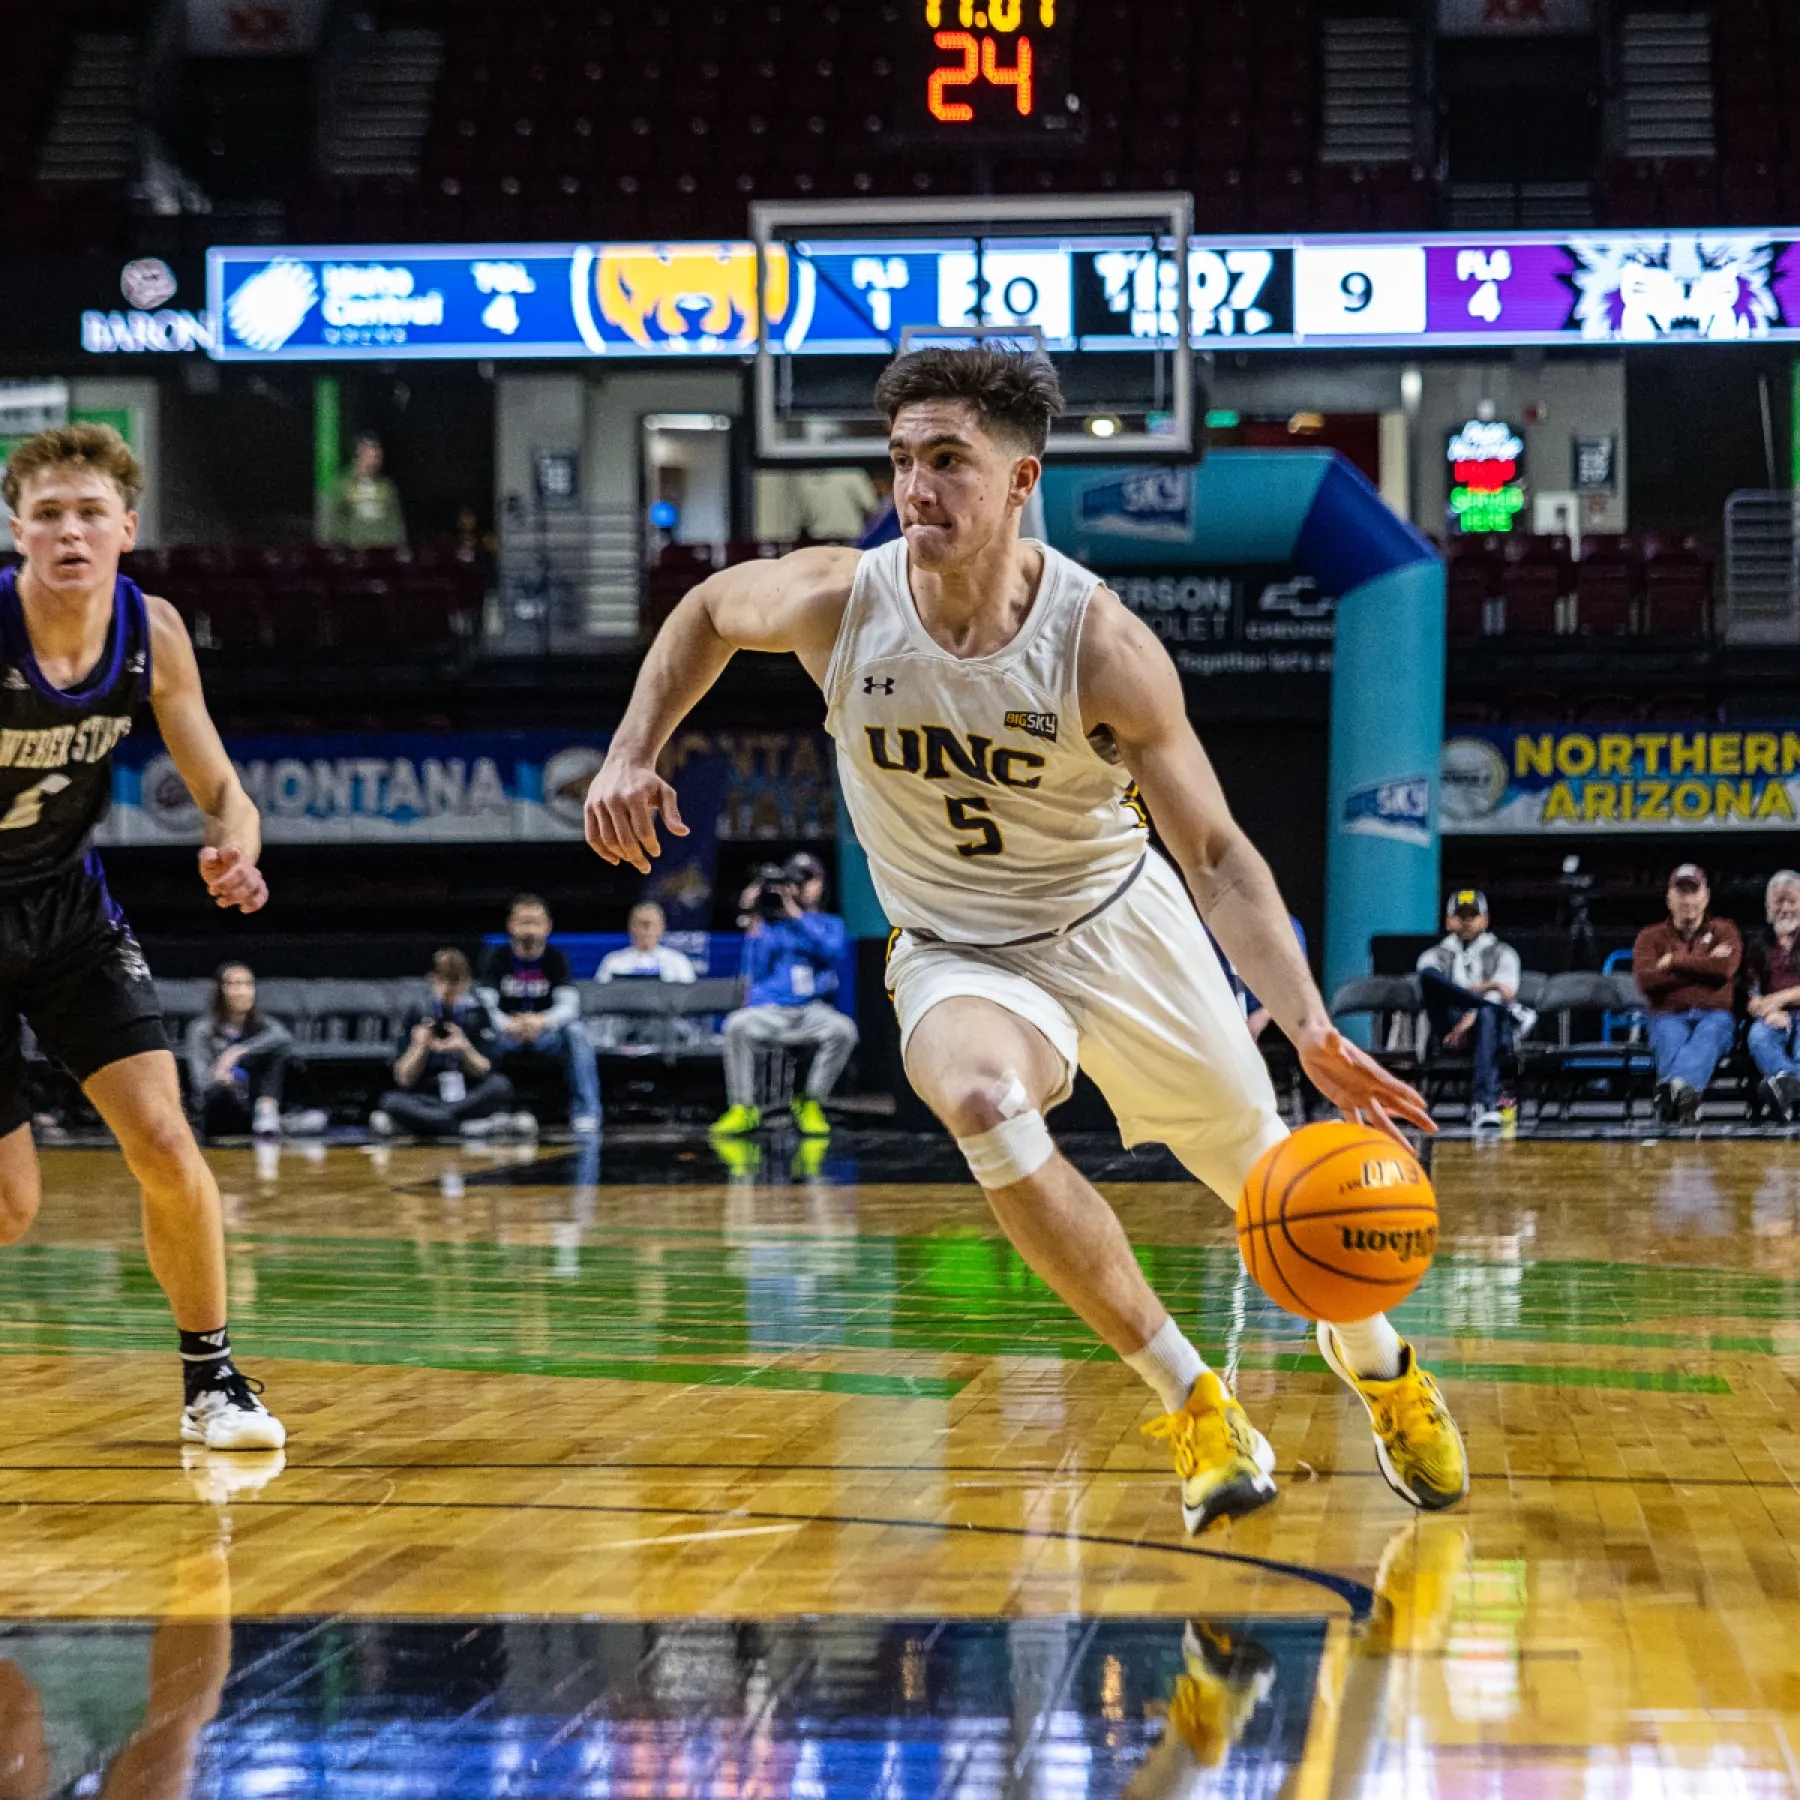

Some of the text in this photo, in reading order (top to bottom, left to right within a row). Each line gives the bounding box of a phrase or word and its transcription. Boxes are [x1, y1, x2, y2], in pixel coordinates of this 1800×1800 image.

[927, 31, 1033, 121] 24
[1339, 271, 1374, 313] 9
[864, 724, 1046, 790] UNC
[944, 794, 1005, 857] 5
[1543, 778, 1794, 823] ARIZONA
